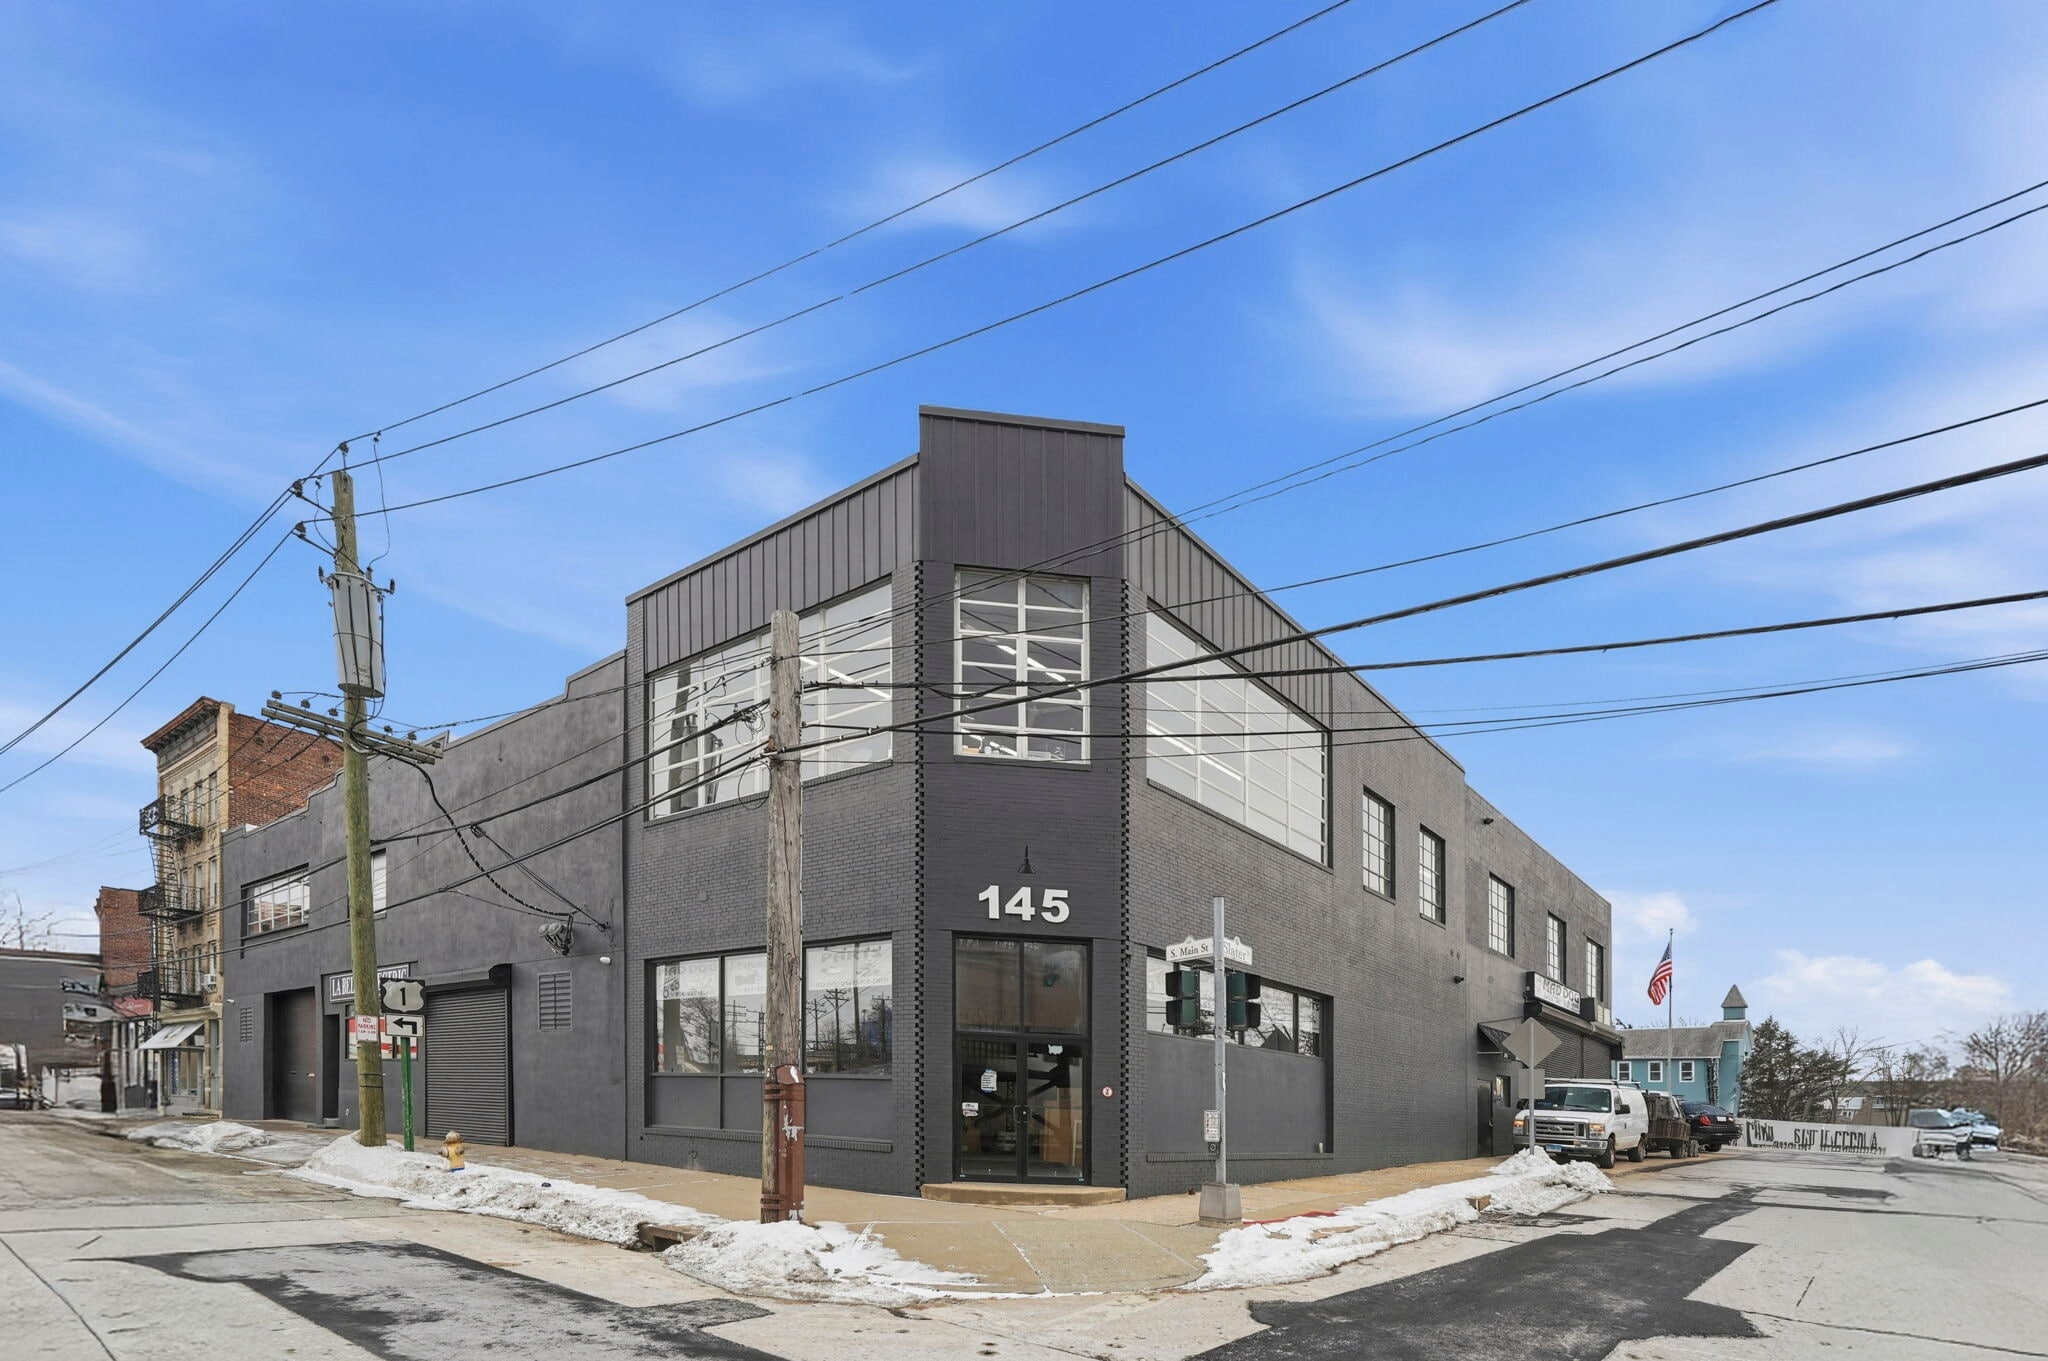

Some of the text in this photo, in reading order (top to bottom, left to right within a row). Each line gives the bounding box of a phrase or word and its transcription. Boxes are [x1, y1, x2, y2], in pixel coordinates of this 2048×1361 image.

[979, 885, 1070, 923] 145
[1170, 943, 1209, 958] S. Main St
[1223, 942, 1247, 961] Slater
[400, 987, 407, 1006] 1
[1542, 978, 1562, 996] MAD
[1563, 987, 1580, 1004] DOG
